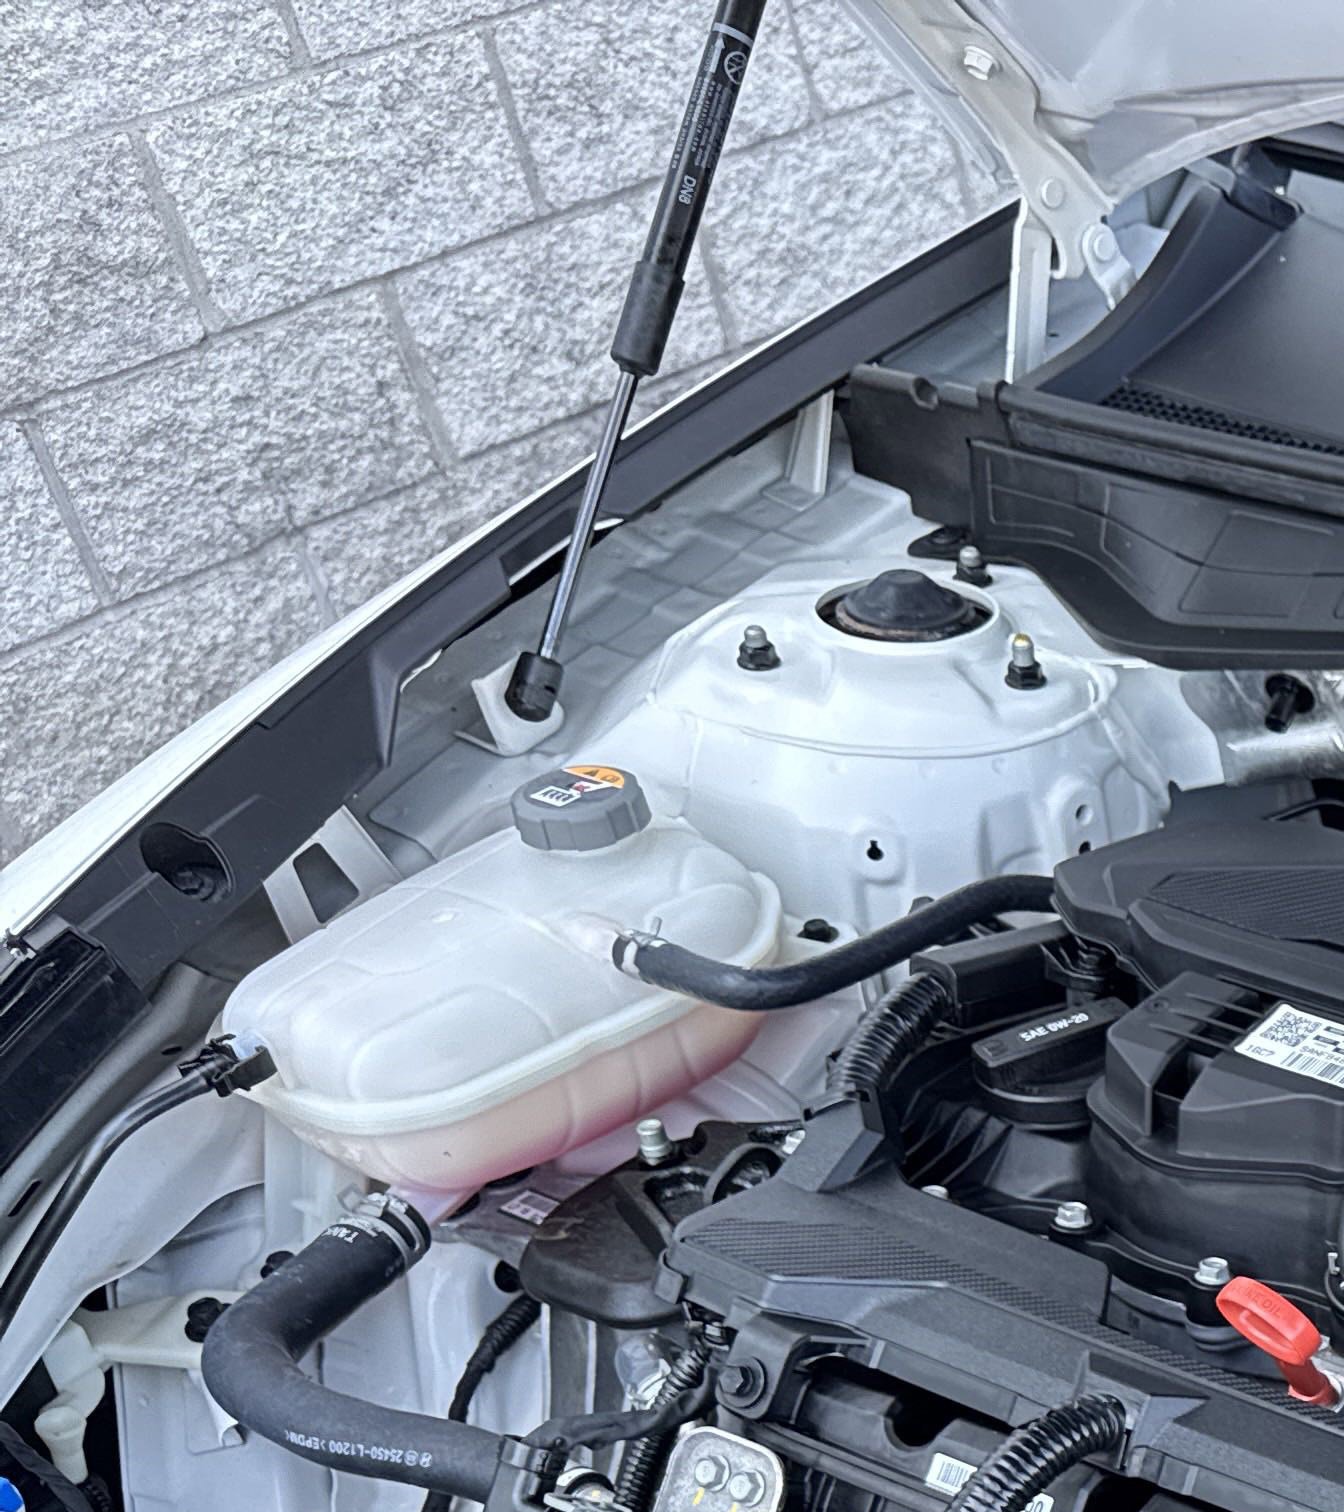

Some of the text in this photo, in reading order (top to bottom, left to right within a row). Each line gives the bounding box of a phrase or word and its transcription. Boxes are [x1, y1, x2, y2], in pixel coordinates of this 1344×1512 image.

[680, 176, 695, 204] DN8
[1019, 1011, 1089, 1042] SAE 0W-20
[328, 1440, 404, 1463] 25450-L1200
